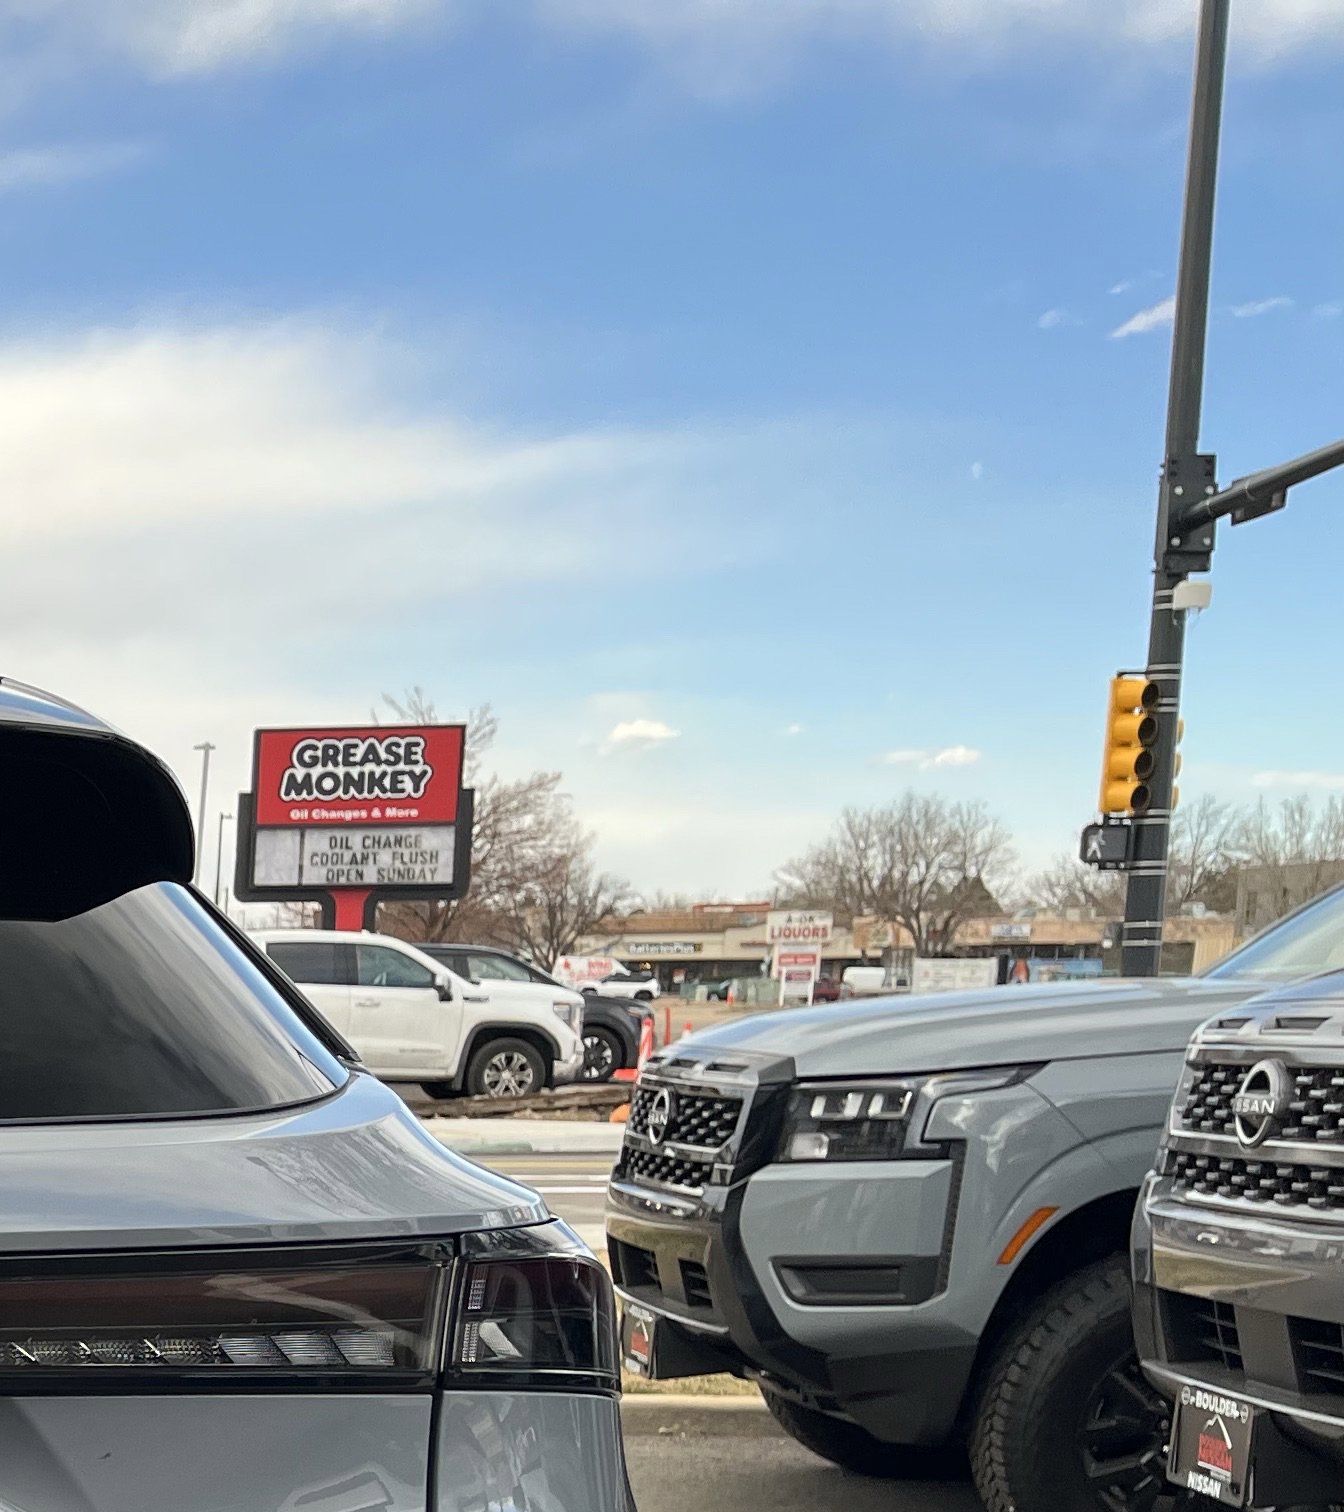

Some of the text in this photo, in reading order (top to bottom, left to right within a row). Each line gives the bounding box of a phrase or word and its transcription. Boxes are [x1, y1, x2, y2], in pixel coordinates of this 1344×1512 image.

[295, 741, 422, 768] GREASE
[283, 769, 429, 797] MONKEY
[289, 807, 419, 821] Oil Changes & More
[329, 834, 423, 850] OIL CHANGE
[310, 851, 439, 867] COOLANT FLUSH
[326, 867, 438, 882] OPEN SUNDAY
[770, 926, 828, 939] LIQUORS
[1195, 1390, 1238, 1418] BOULDER
[1188, 1470, 1222, 1498] NISSAN
